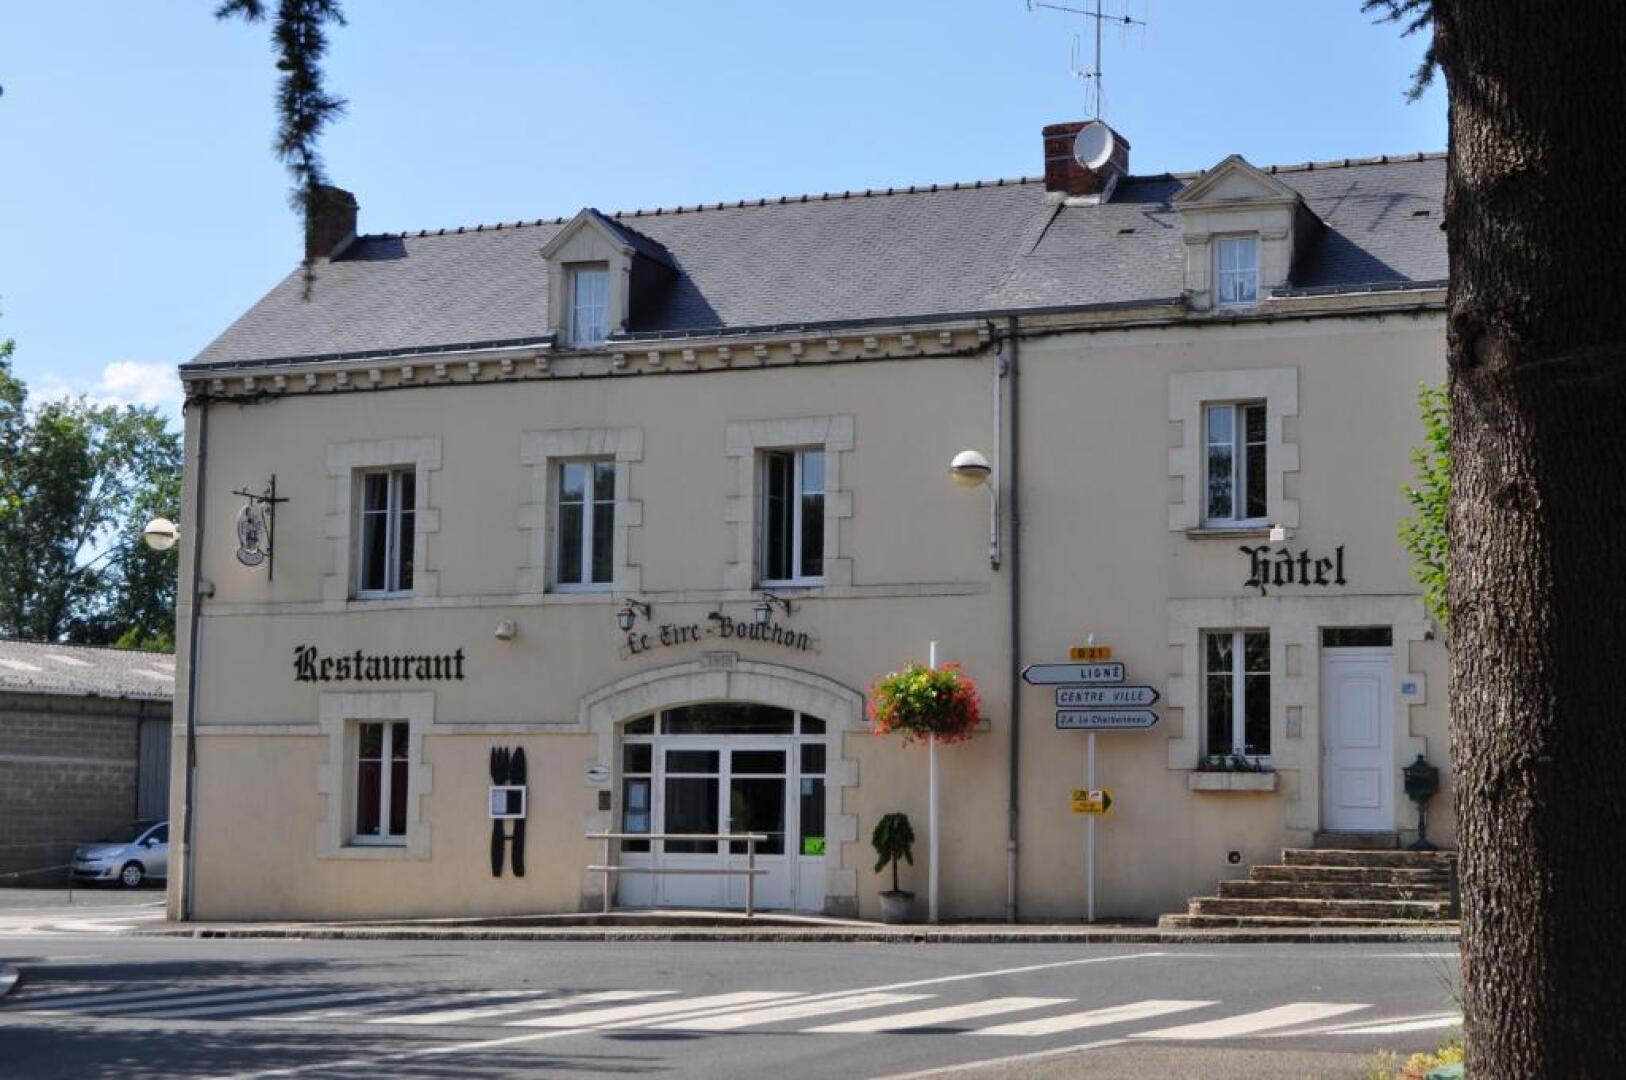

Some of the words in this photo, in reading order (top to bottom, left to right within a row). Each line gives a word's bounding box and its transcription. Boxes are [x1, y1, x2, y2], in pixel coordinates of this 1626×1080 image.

[293, 644, 465, 683] Restaurant
[1080, 666, 1121, 679] LIGNÉ
[1060, 691, 1104, 702] CENTRE
[1113, 691, 1145, 702] VILLE
